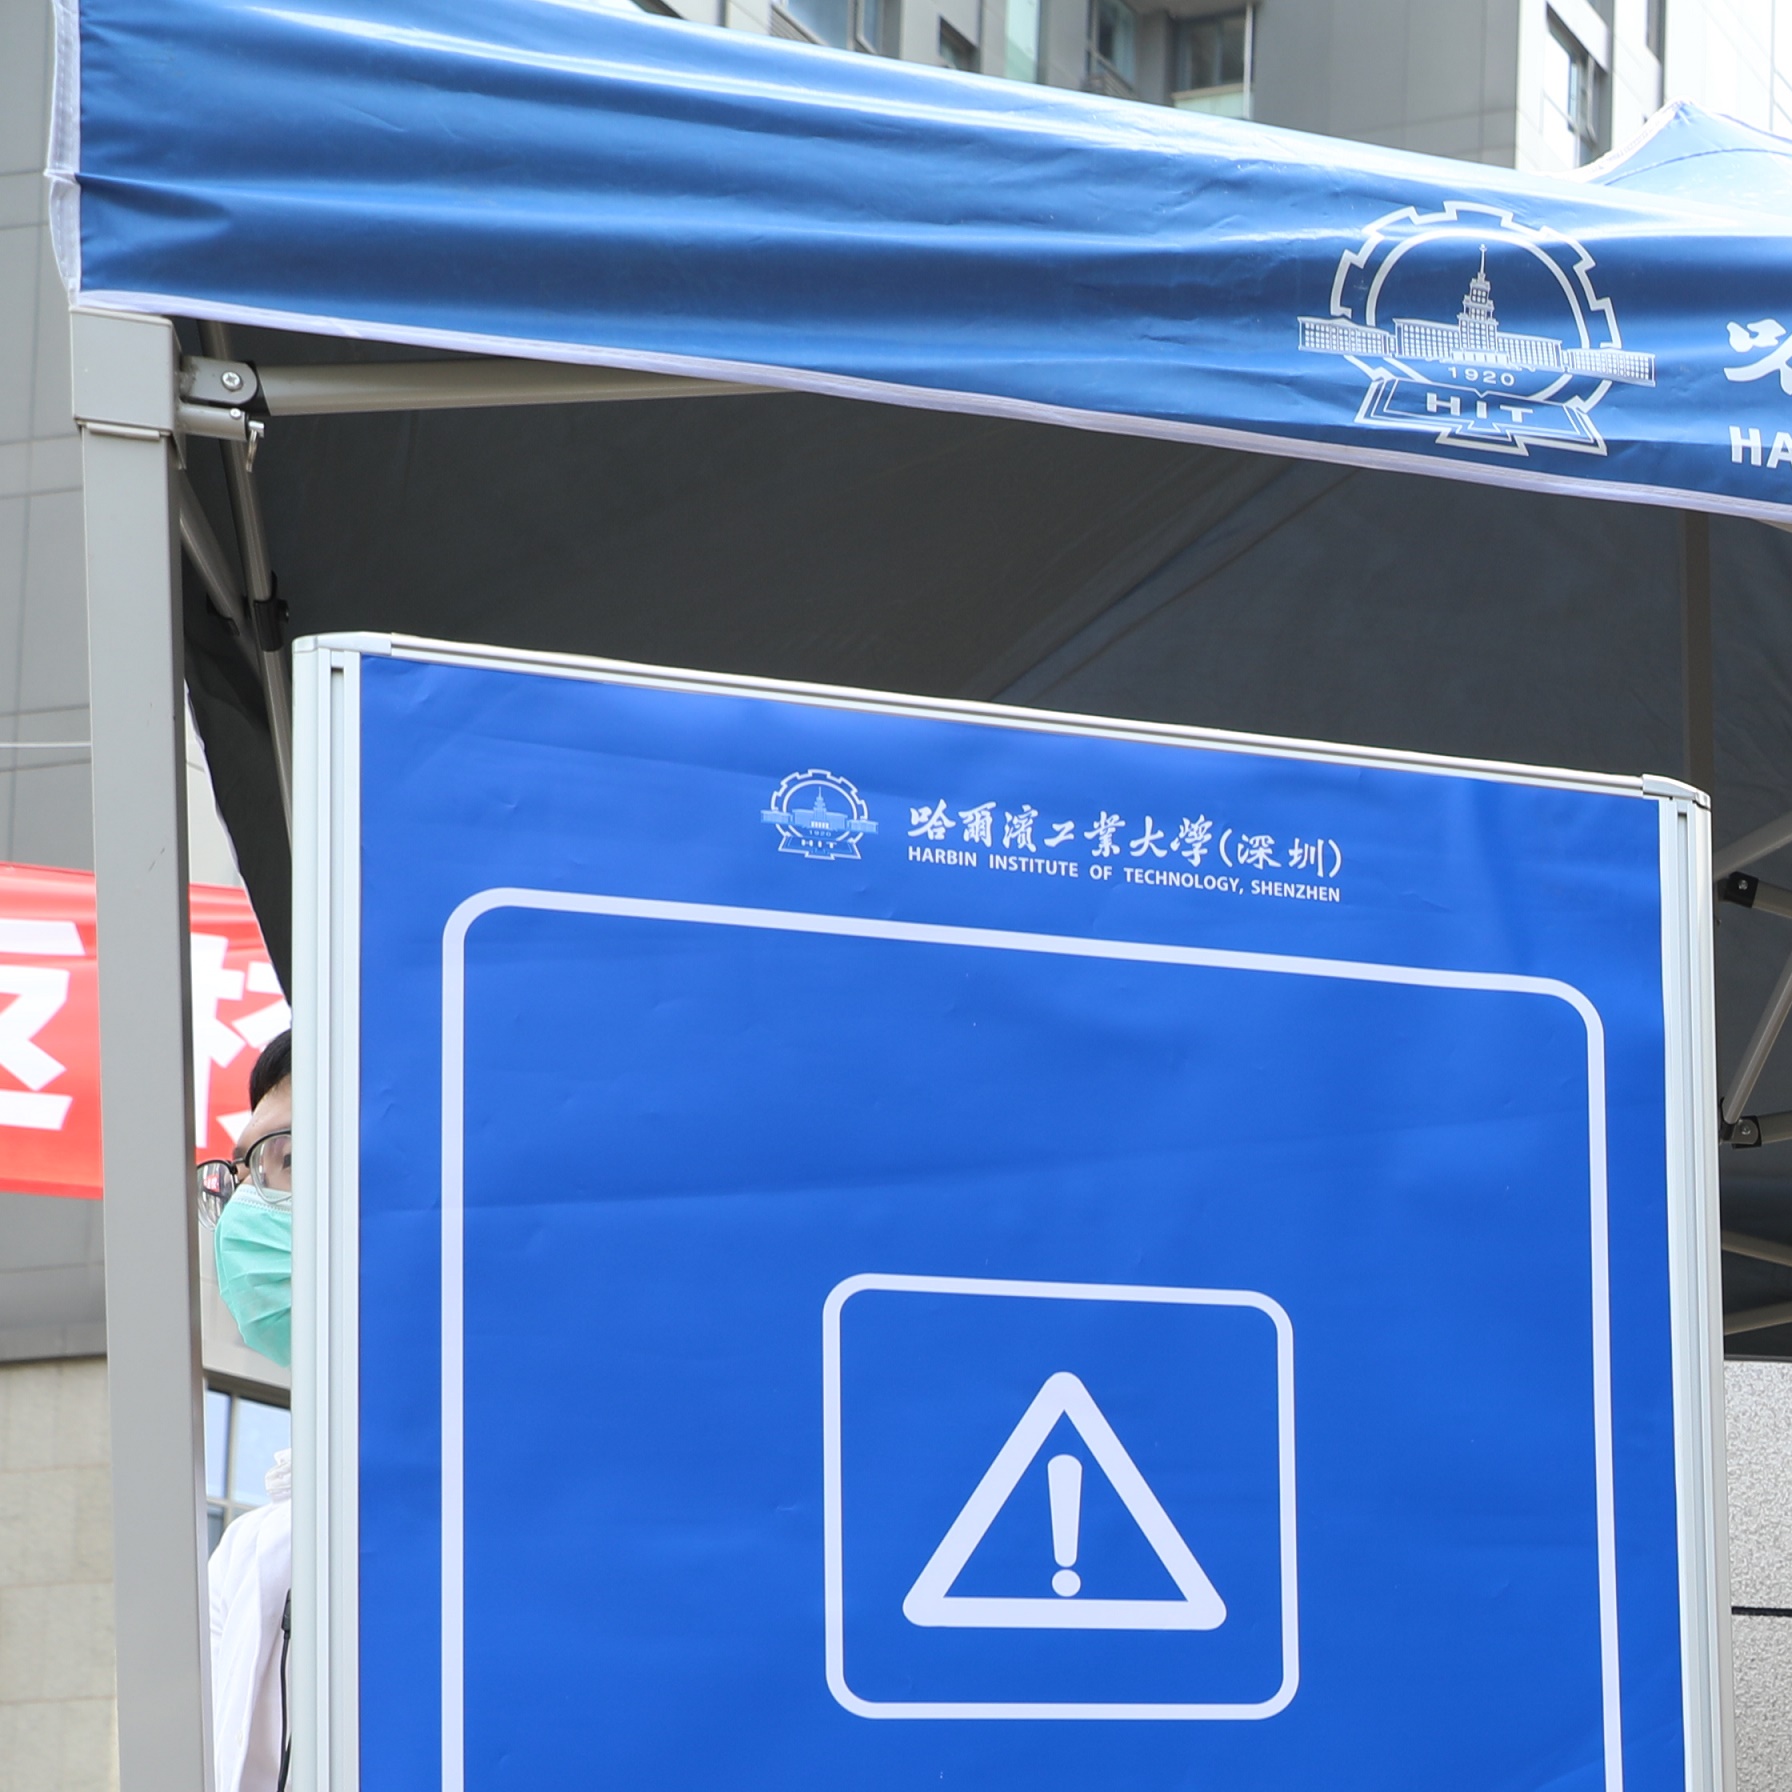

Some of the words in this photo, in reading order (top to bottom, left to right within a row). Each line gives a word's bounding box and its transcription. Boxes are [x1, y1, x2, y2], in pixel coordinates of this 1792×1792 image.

[1447, 366, 1515, 387] 1920
[1426, 392, 1533, 423] HIT
[801, 839, 837, 849] HIT
[908, 845, 977, 868] HARBIN
[988, 854, 1079, 878] INSTITUTE
[1090, 864, 1112, 881] OF
[1124, 867, 1245, 895] TECHNOLOGY,
[1250, 879, 1341, 902] SHENZHEN
